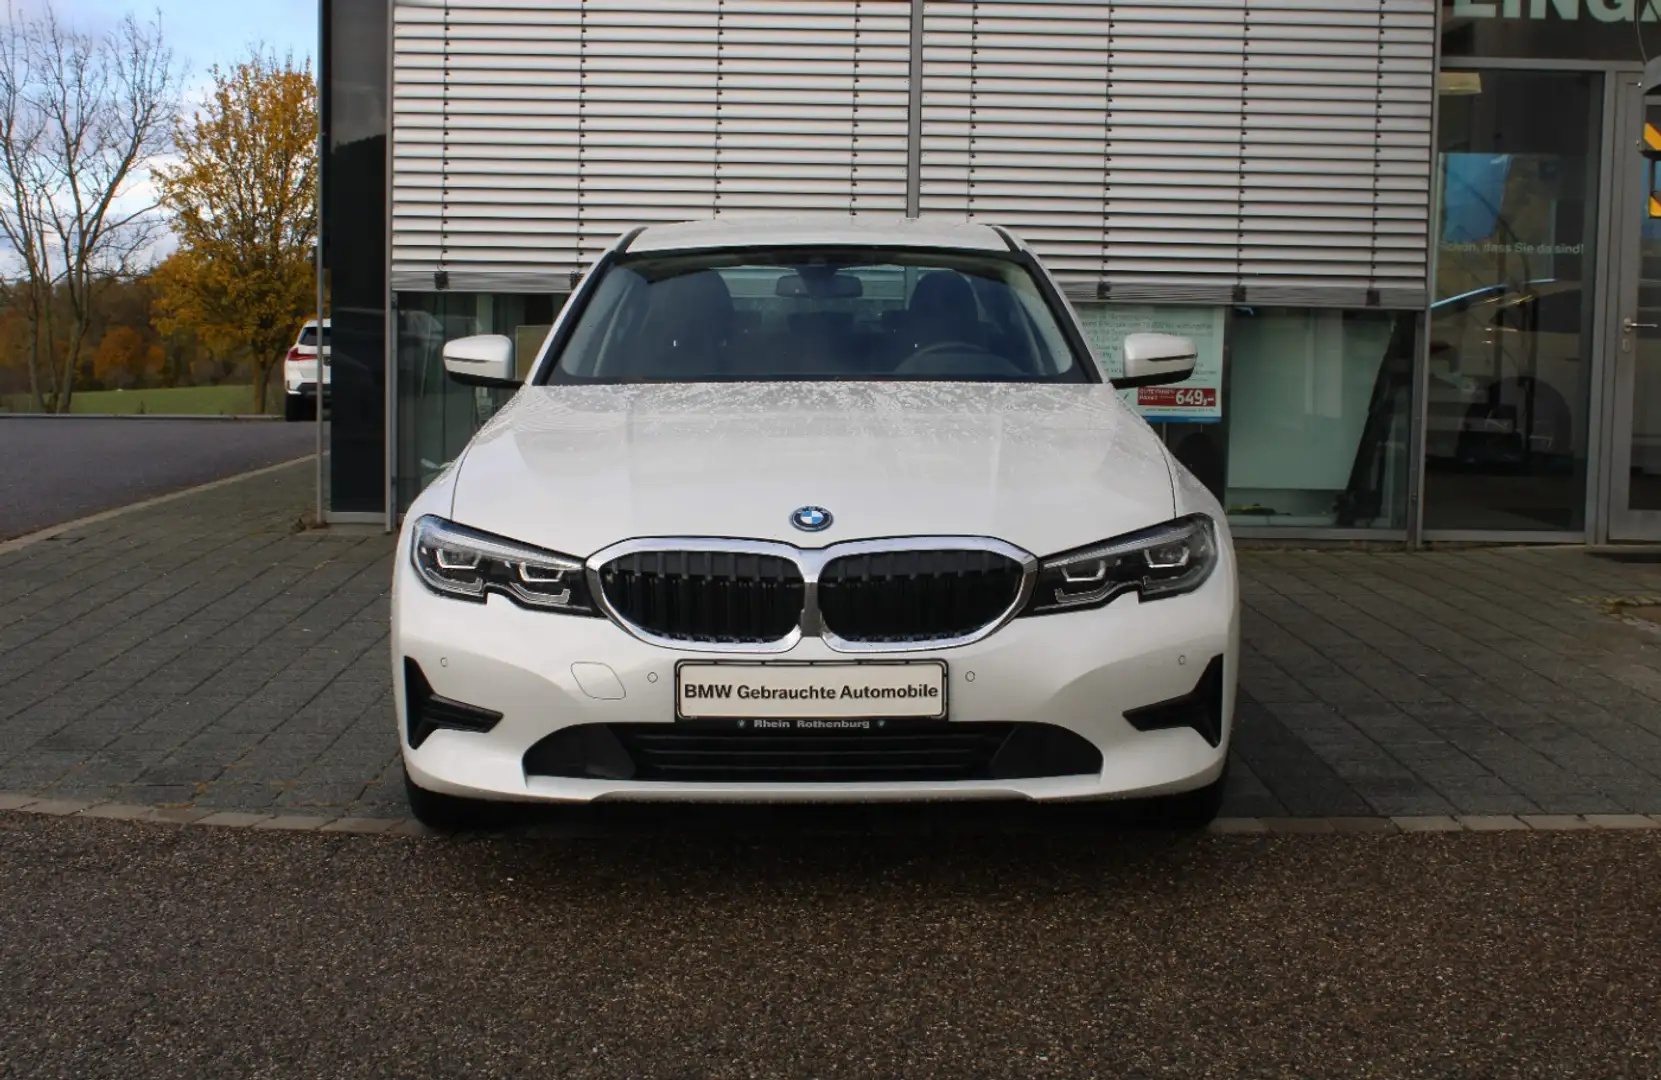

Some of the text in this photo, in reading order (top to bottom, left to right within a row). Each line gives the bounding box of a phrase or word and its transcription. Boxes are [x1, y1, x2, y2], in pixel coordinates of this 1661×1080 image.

[1514, 242, 1535, 253] Sie
[1536, 242, 1552, 254] da
[684, 683, 938, 700] BMW Gebrauchte Automobile
[753, 719, 870, 729] Rhein Rothenburg
